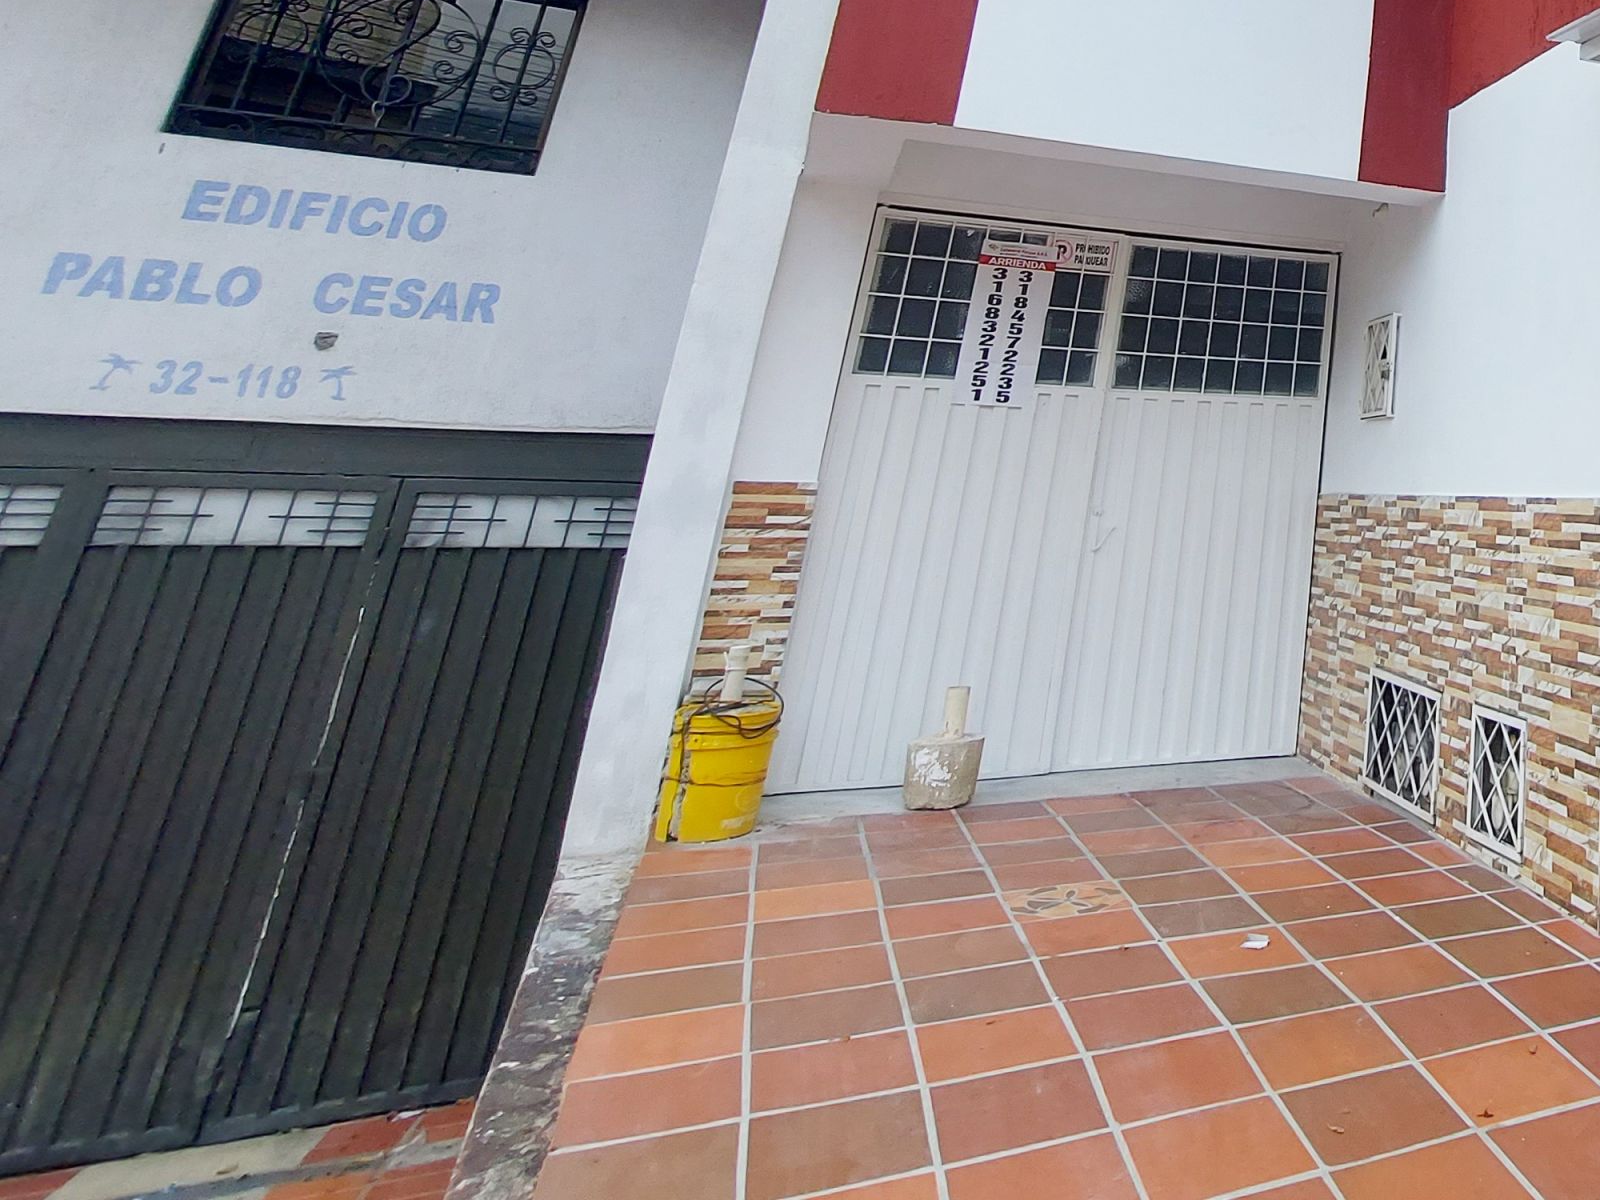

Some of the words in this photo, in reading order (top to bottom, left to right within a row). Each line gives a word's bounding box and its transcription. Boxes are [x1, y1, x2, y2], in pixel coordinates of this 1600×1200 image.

[181, 179, 447, 242] EDIFICIO
[41, 251, 262, 307] PABLO
[313, 272, 501, 324] CESAR
[988, 257, 1047, 270] ARRIENDA
[149, 360, 302, 399] 32-118
